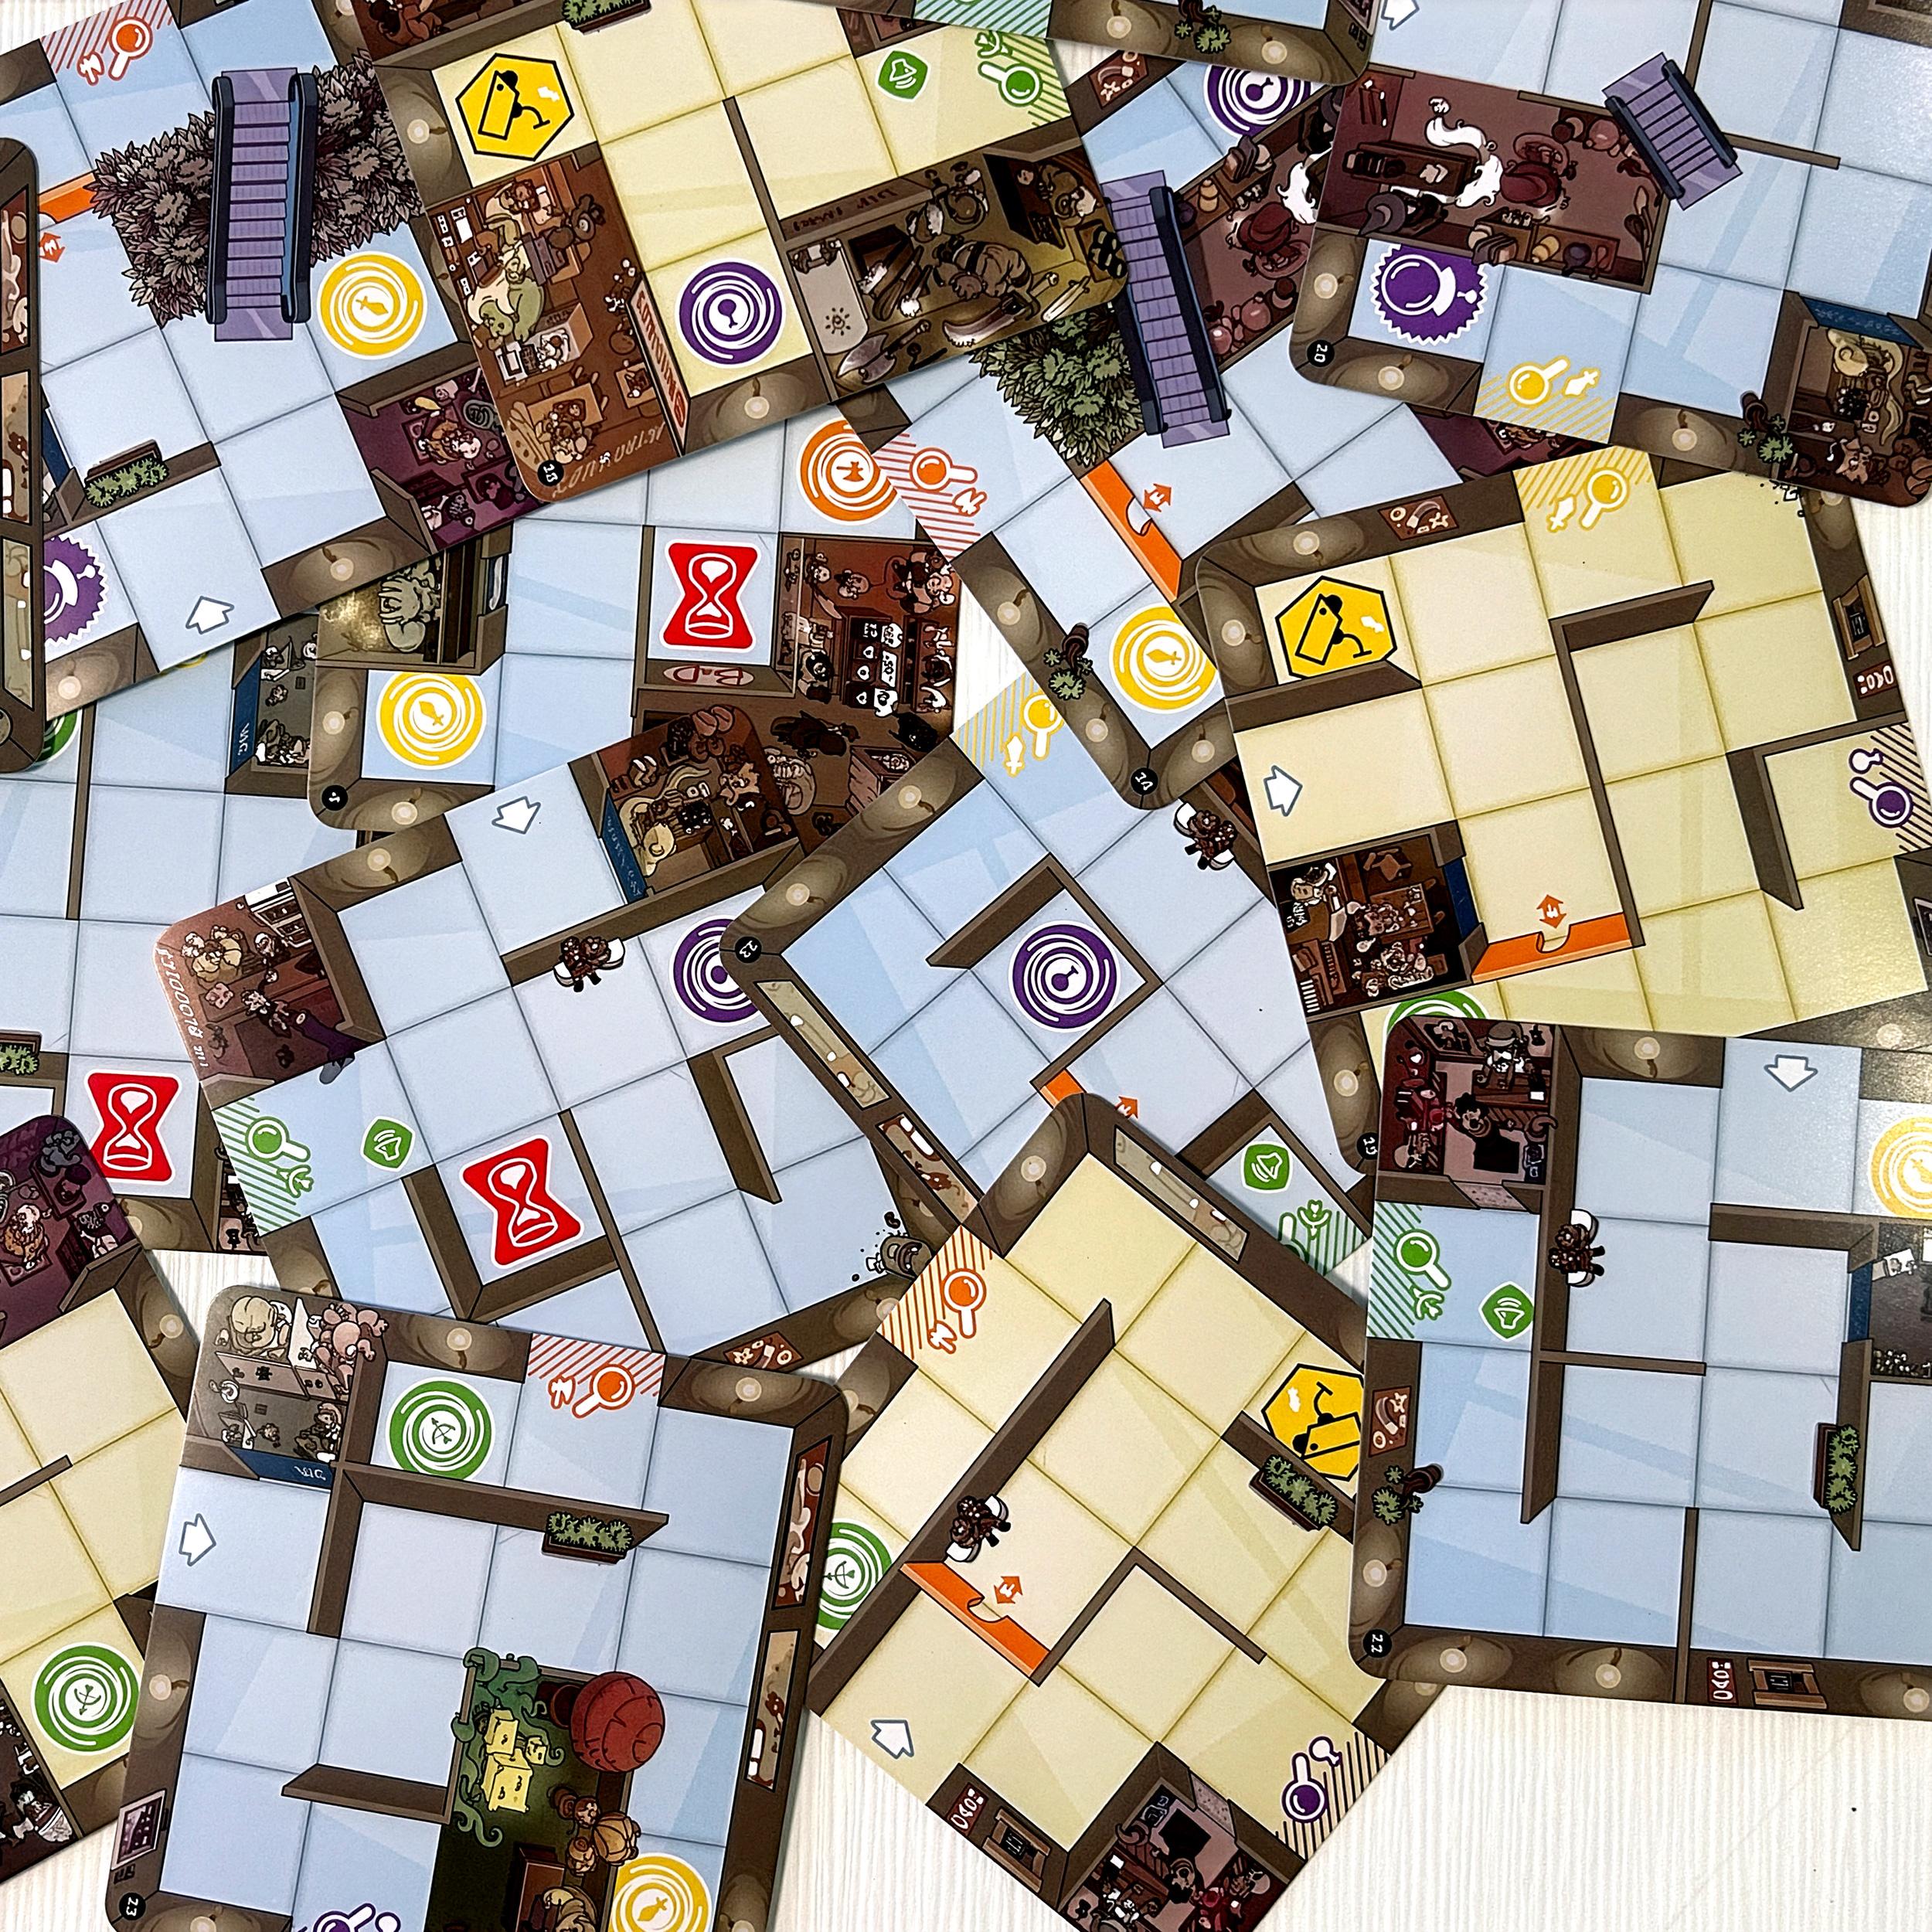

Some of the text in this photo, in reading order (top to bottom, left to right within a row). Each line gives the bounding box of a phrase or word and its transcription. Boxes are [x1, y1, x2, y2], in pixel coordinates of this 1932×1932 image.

[1314, 345, 1328, 363] 20
[1372, 1634, 1384, 1653] 22
[125, 1897, 138, 1916] 23
